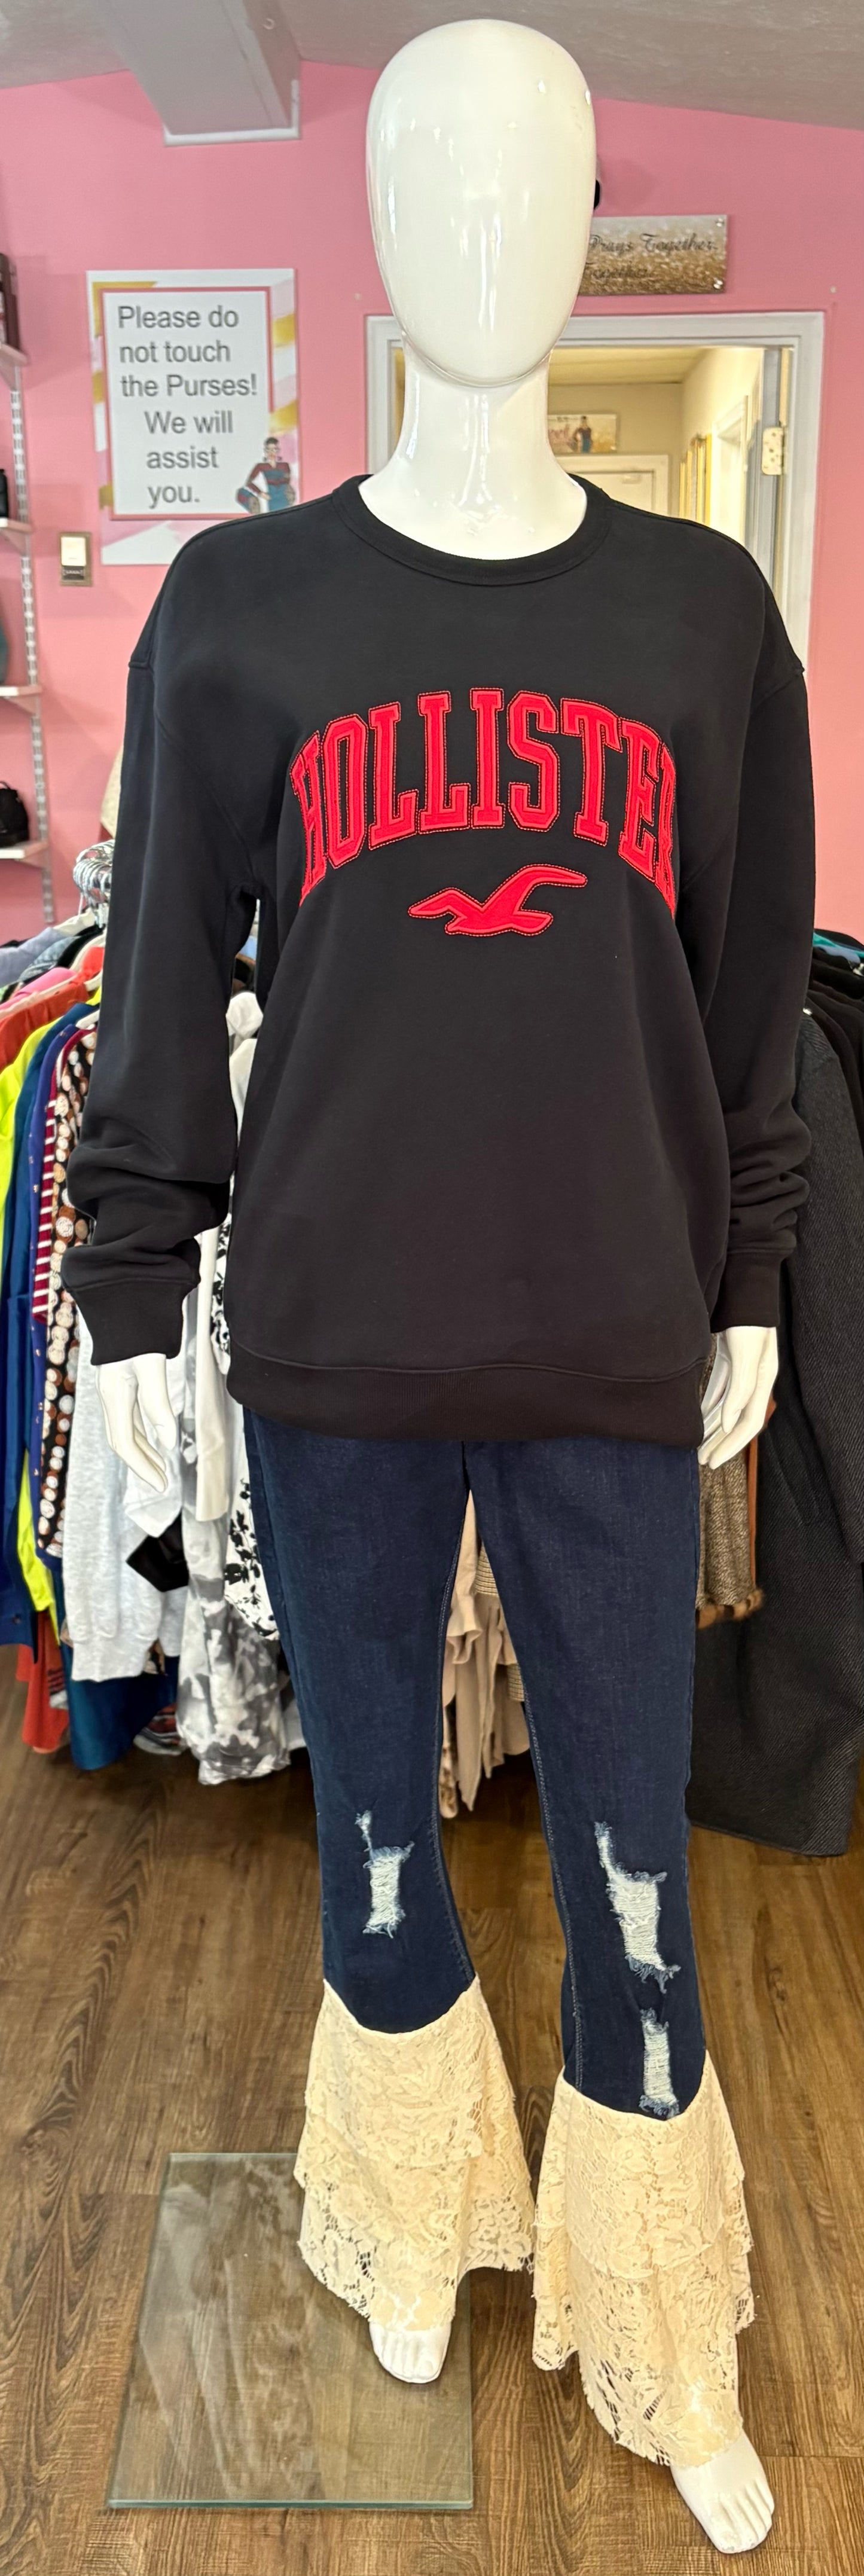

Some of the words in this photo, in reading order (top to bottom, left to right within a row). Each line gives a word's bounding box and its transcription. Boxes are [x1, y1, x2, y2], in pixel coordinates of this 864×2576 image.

[118, 305, 200, 328] Please
[208, 305, 239, 328] do
[120, 342, 158, 363] not
[165, 340, 231, 362] touch
[120, 376, 158, 397] the
[167, 374, 257, 396] Purses!
[144, 411, 187, 434] We
[194, 411, 233, 434] will
[146, 446, 219, 469] assist
[148, 486, 200, 509] you.
